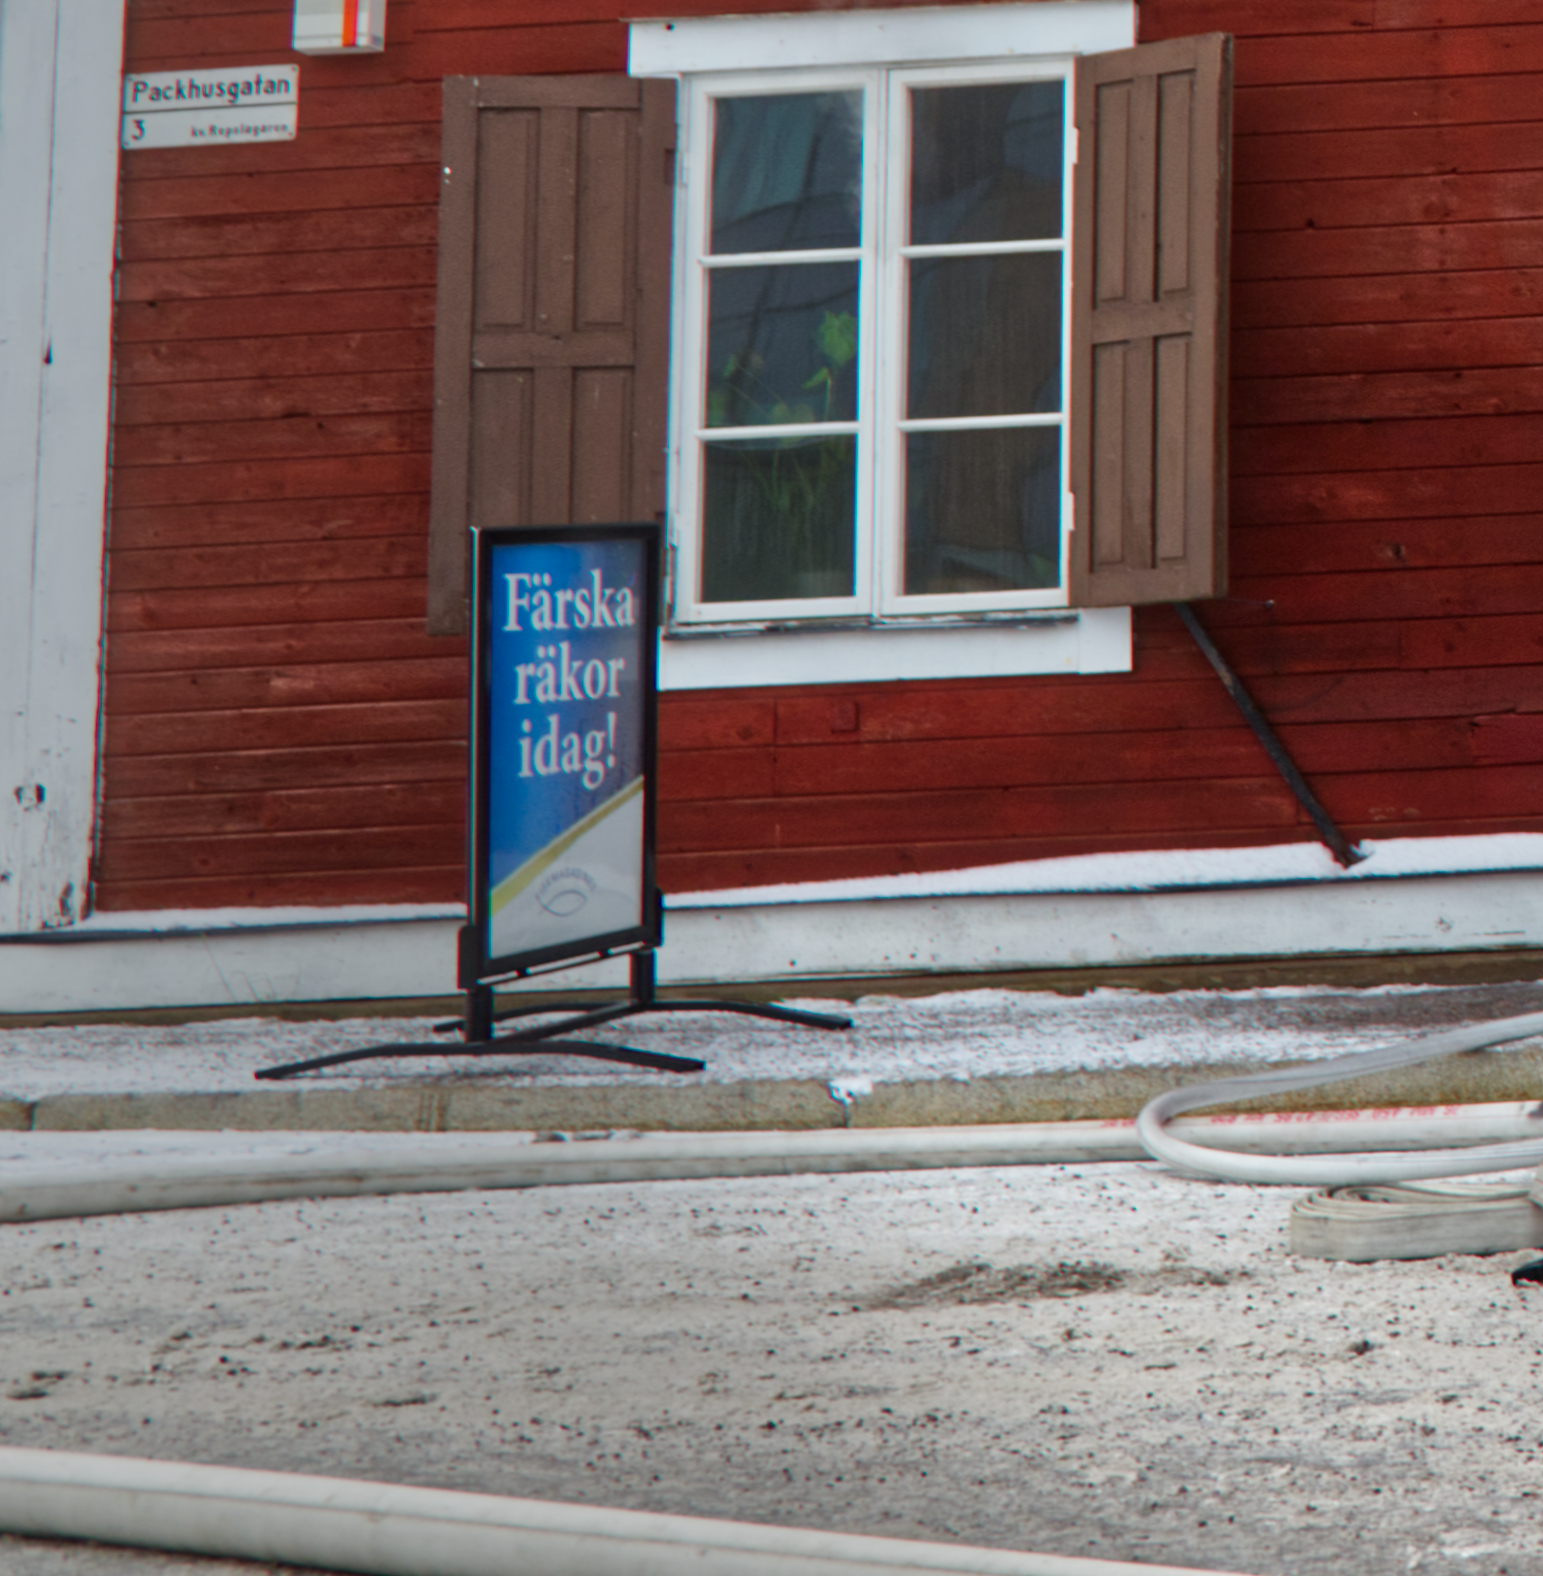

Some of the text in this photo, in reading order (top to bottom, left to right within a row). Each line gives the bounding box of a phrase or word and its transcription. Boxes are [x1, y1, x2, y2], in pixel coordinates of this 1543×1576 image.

[131, 73, 291, 105] Packhusgatan
[131, 119, 146, 140] 3
[502, 568, 636, 632] Färska
[513, 641, 626, 705] räkor
[517, 712, 618, 791] idag!
